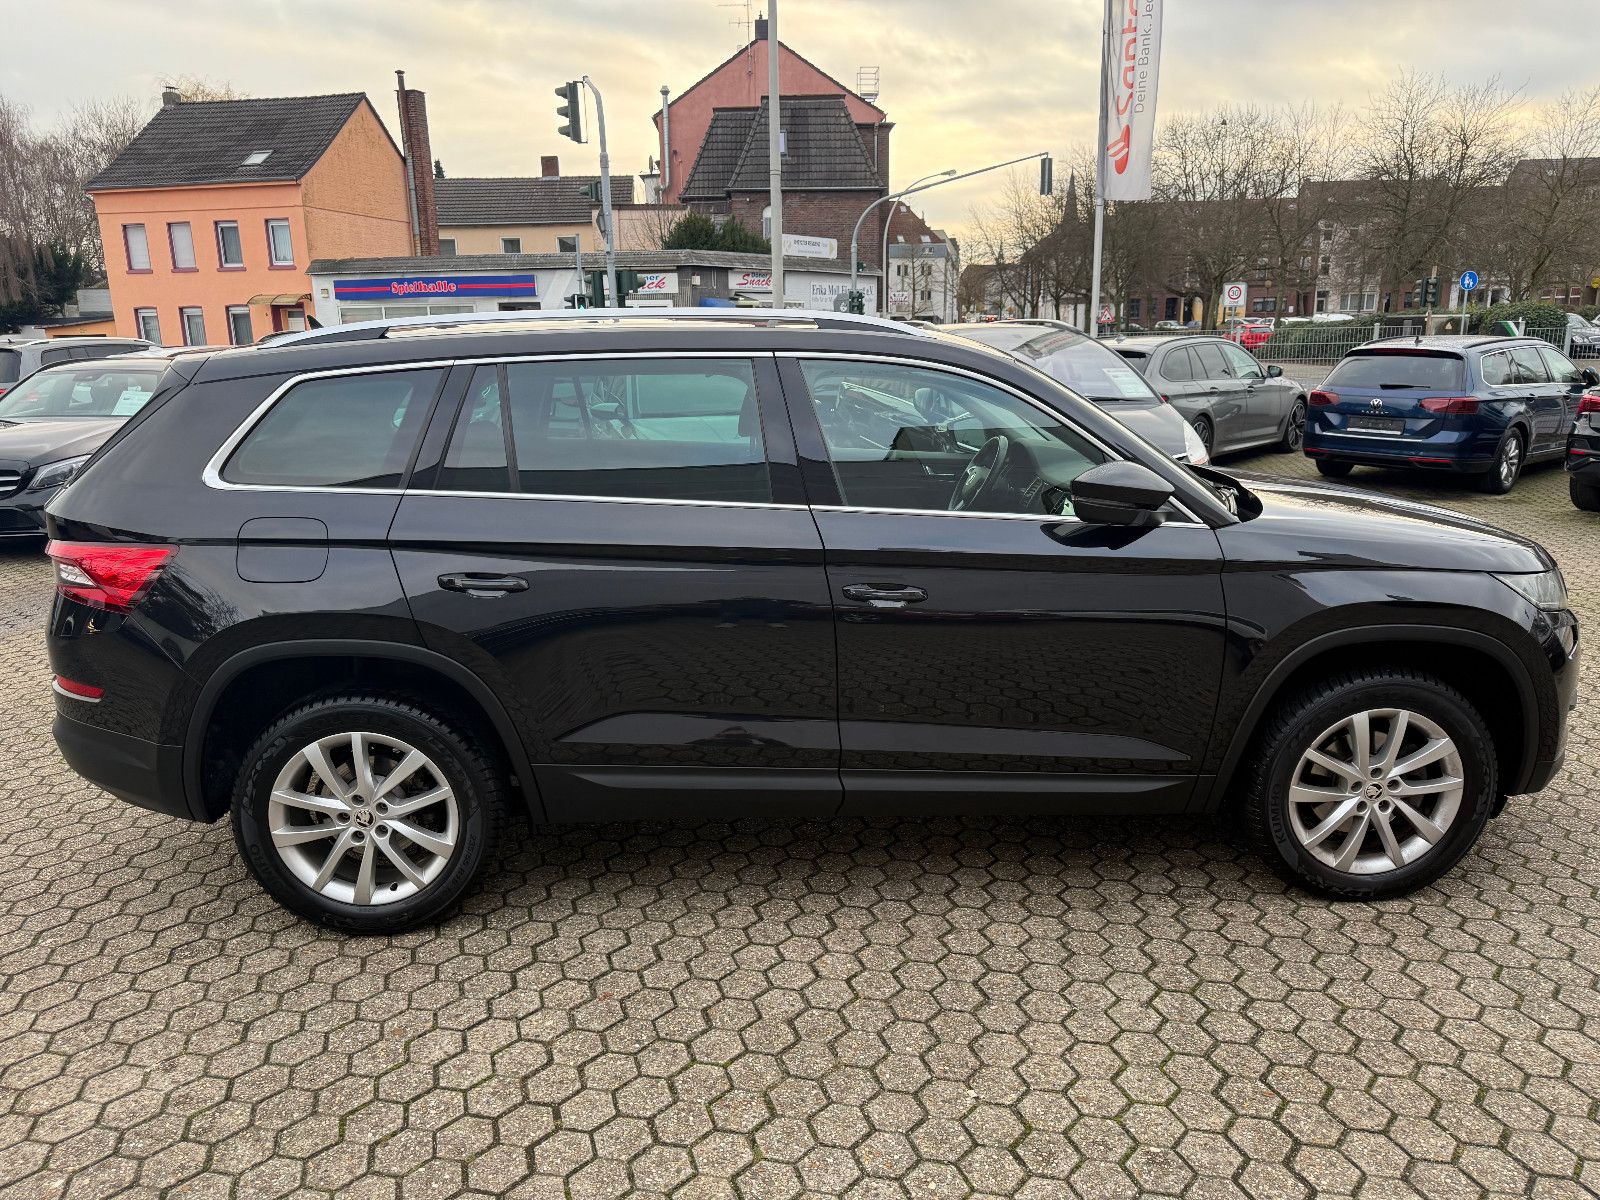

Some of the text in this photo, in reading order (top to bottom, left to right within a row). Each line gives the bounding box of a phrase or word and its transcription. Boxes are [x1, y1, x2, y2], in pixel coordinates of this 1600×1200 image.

[1138, 23, 1152, 66] Bank.
[1134, 70, 1147, 113] Deine
[391, 281, 457, 295] Spielhalle
[1231, 289, 1239, 297] 30
